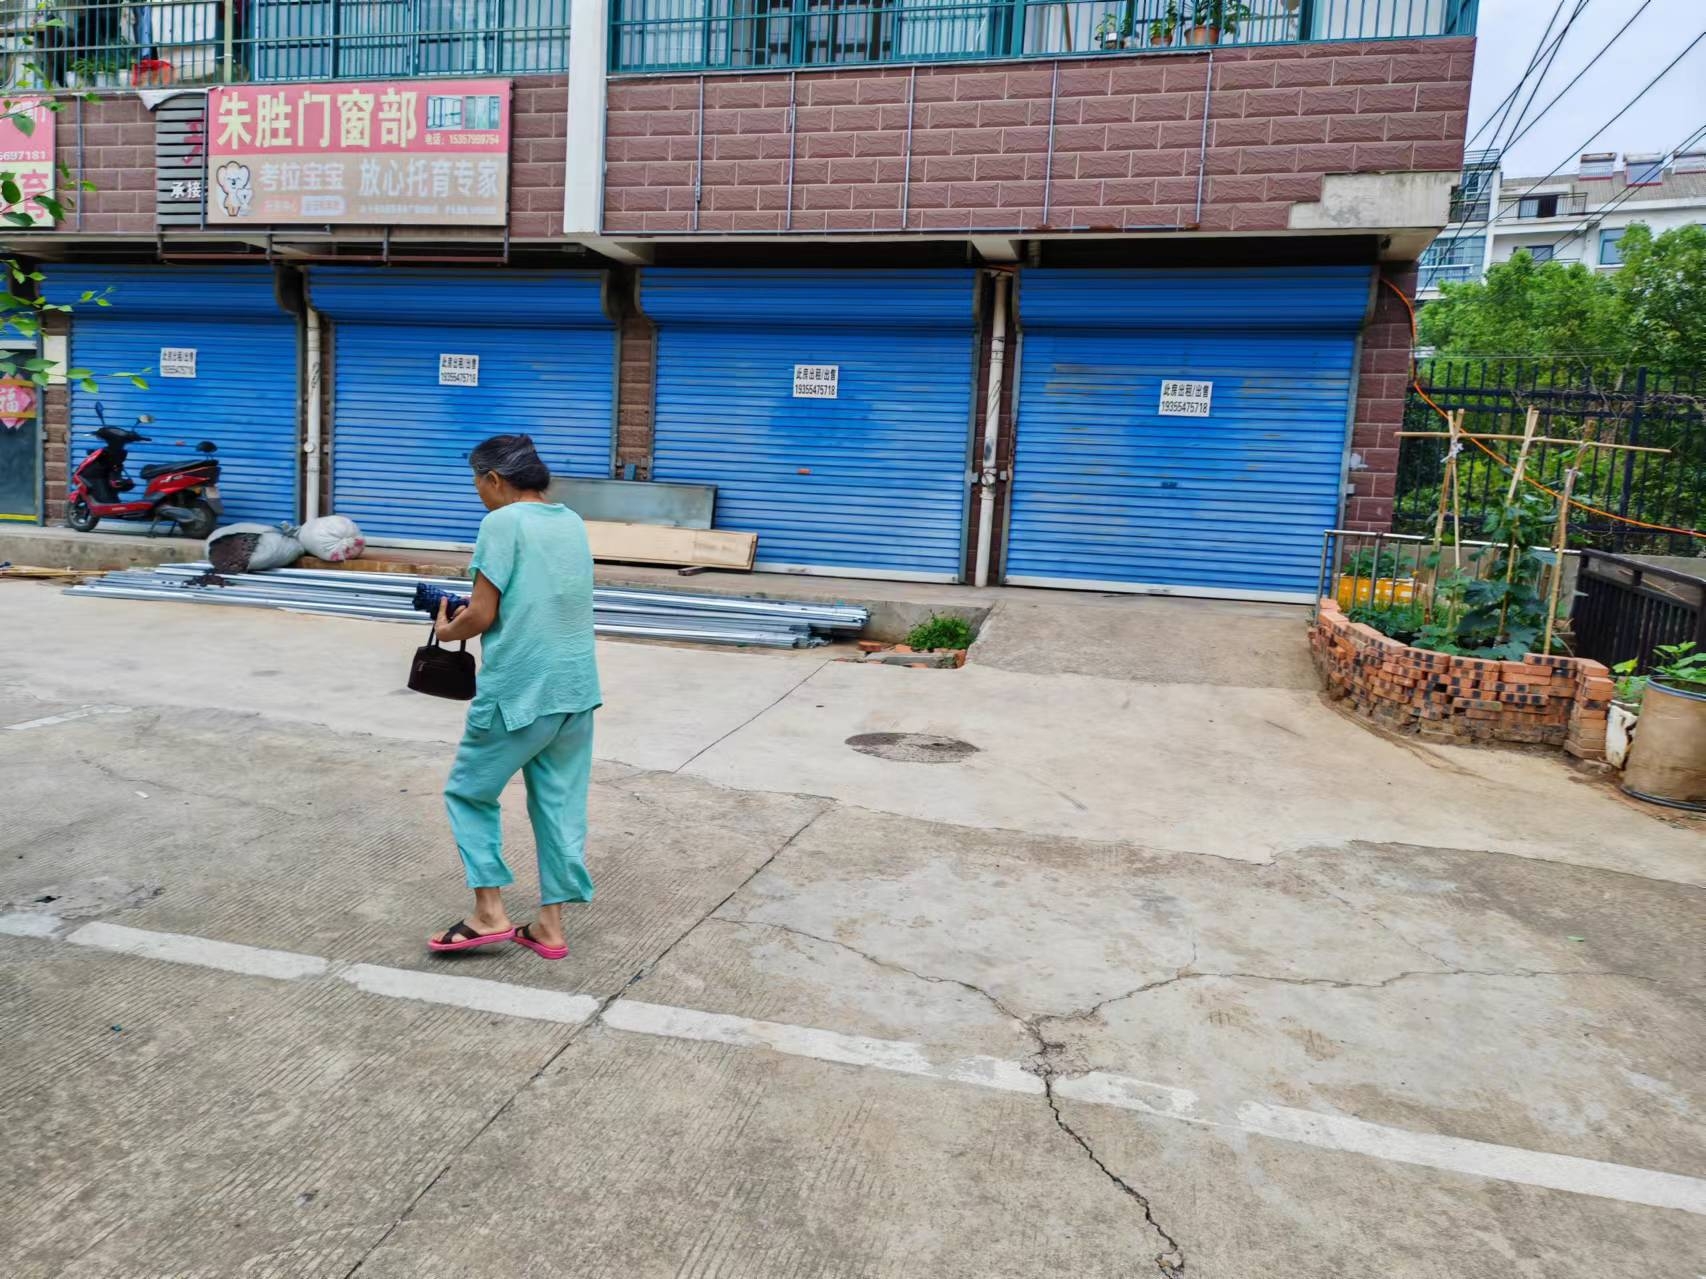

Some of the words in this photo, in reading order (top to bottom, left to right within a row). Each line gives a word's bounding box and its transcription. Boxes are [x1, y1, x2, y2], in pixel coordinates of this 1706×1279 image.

[216, 87, 418, 149] 朱胜门窗部
[359, 157, 499, 198] 放心托育专家
[170, 181, 208, 199] 承接
[795, 383, 836, 396] 19355475718
[1161, 400, 1208, 414] 19355475718
